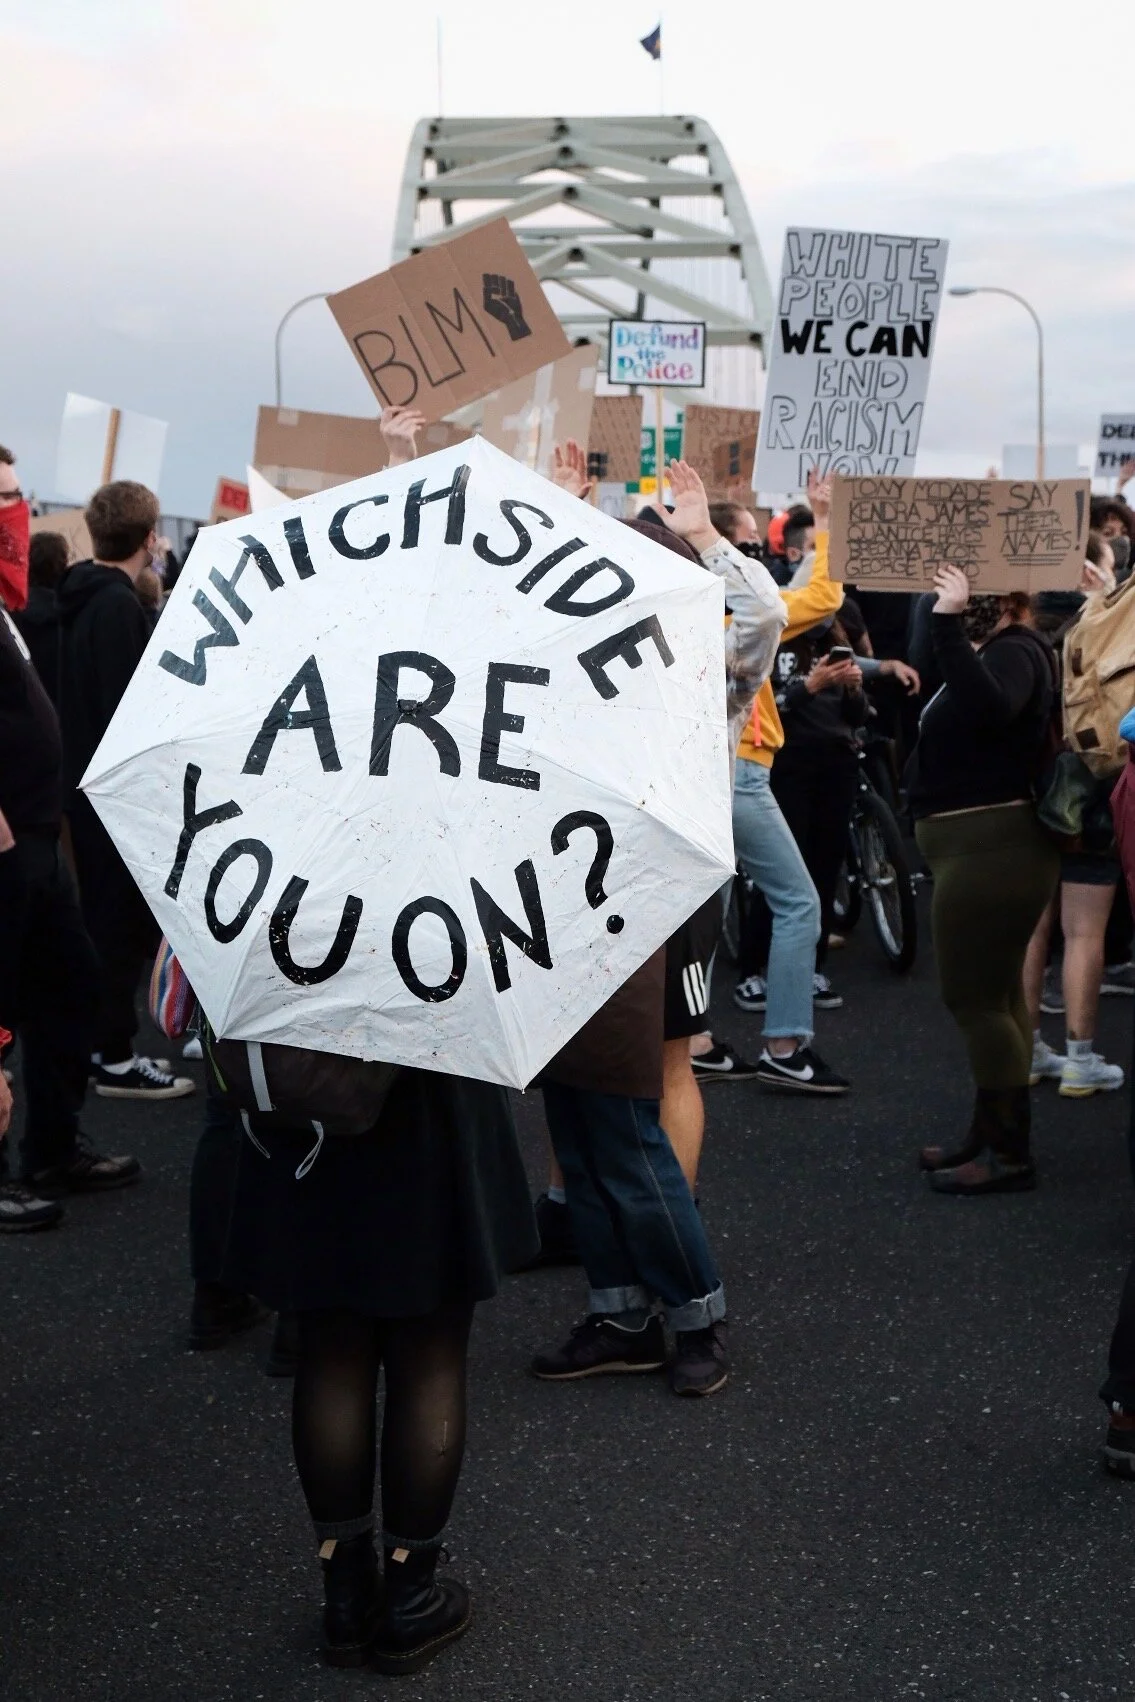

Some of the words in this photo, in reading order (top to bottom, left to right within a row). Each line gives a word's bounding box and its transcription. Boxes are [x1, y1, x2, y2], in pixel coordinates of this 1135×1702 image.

[787, 232, 940, 281] WHITE
[779, 274, 939, 323] PEOPLE
[352, 287, 496, 407] BLM
[616, 324, 698, 350] Defund
[780, 319, 833, 355] WE
[845, 320, 931, 358] CAN
[617, 355, 694, 380] Police
[814, 359, 908, 399] END
[766, 395, 924, 457] RACISM
[844, 478, 907, 500] TONY
[1009, 484, 1058, 511] SAY
[849, 501, 921, 523] KENDRA
[926, 501, 989, 525] JAMES
[997, 509, 1063, 532] THEIR
[157, 464, 471, 687] WHICH
[473, 498, 676, 700] SIDE
[845, 557, 917, 577] GEORGE
[241, 650, 551, 791] ARE
[164, 762, 364, 986] YOU
